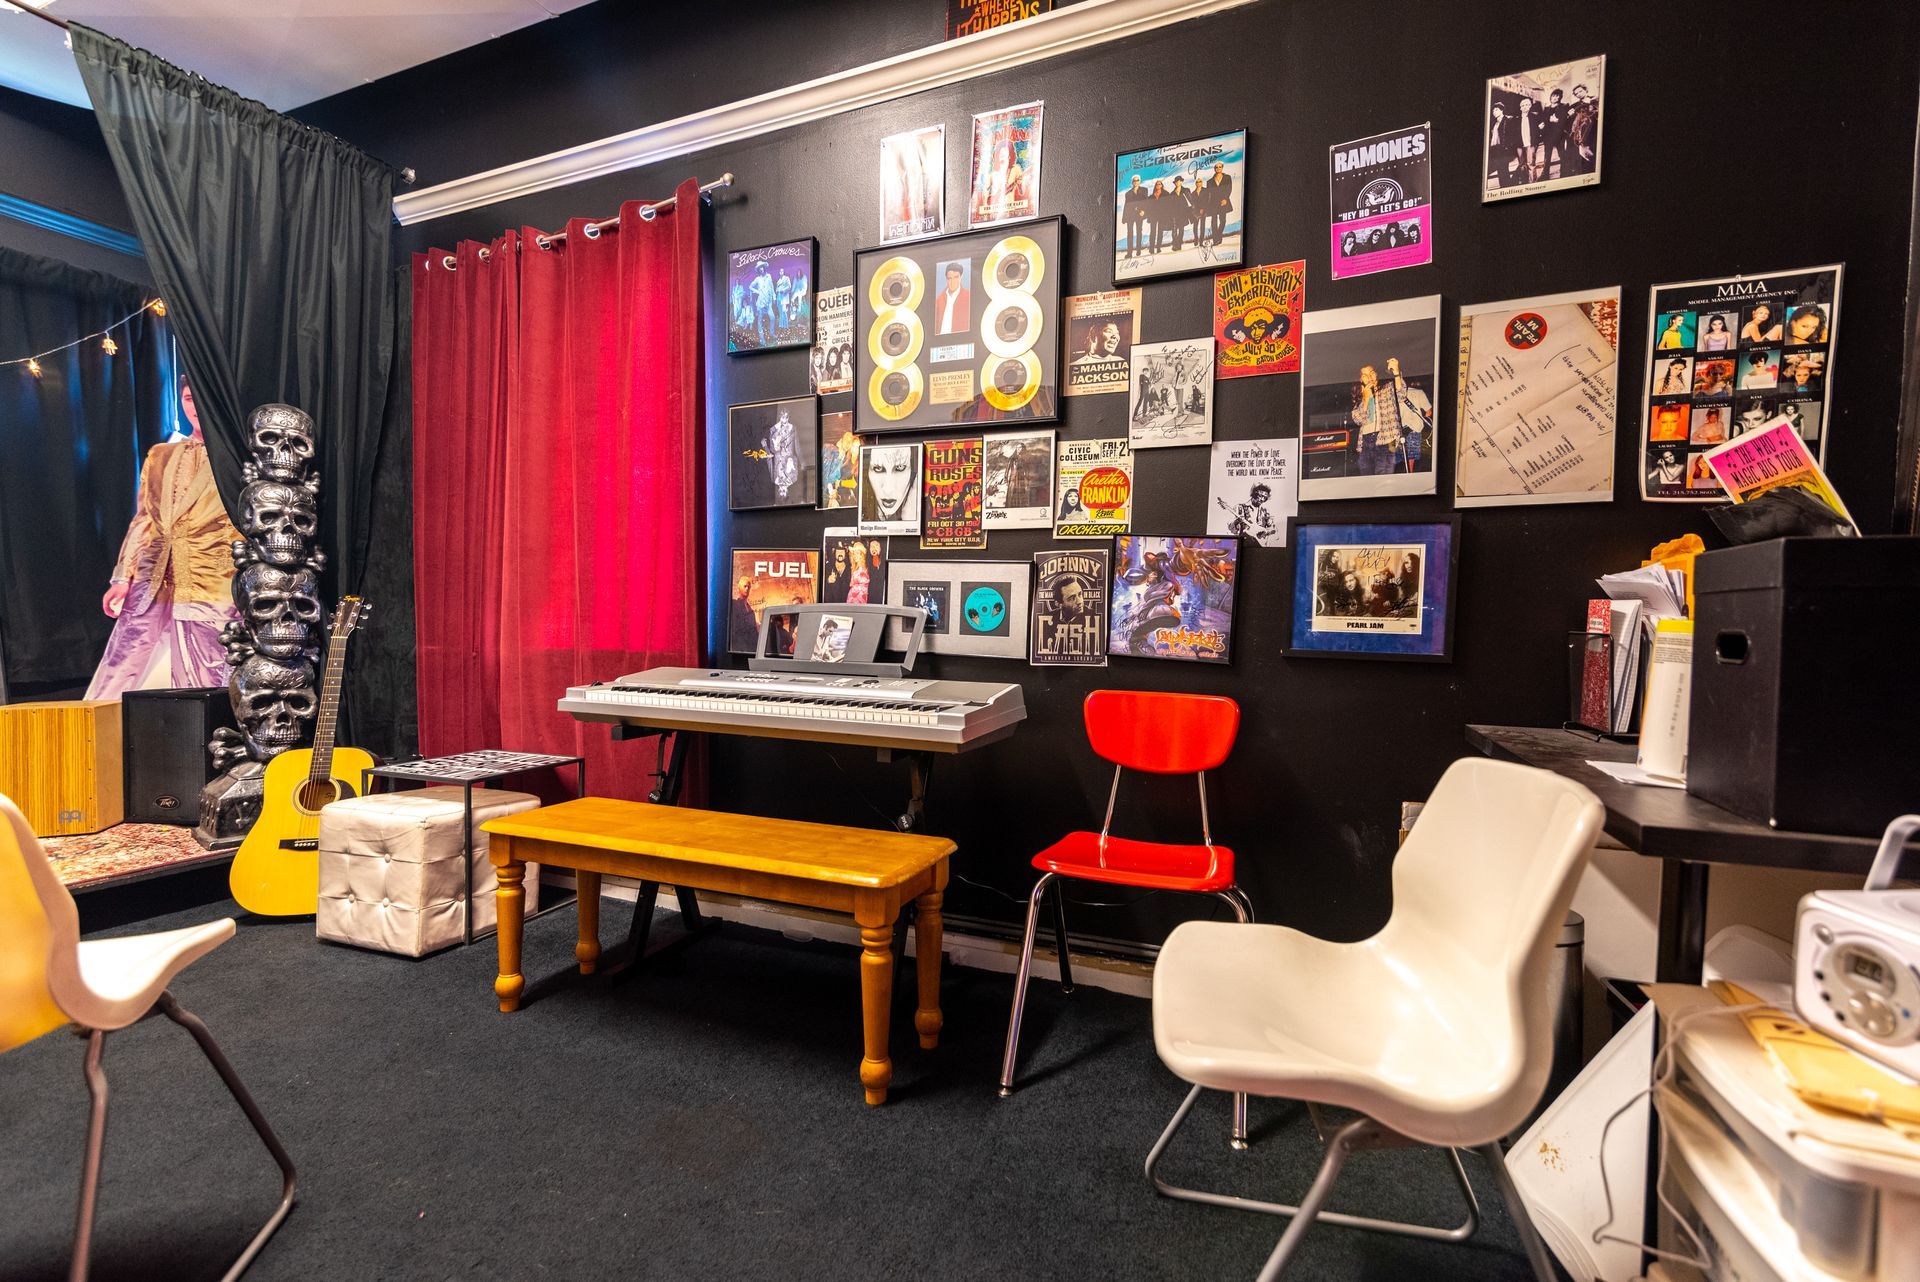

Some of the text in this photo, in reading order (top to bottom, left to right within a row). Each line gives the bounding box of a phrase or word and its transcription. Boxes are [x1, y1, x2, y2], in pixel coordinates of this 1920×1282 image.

[981, 0, 1017, 16] WHERE
[973, 1, 1039, 33] HAPPENS
[1132, 144, 1222, 169] SCORPIONS
[1335, 133, 1426, 174] RAMONES
[1500, 189, 1523, 197] Rolling
[1359, 209, 1369, 218] HO
[1380, 202, 1400, 213] LET'S
[736, 249, 768, 268] Black
[767, 247, 805, 258] Crowes
[1219, 270, 1304, 300] JIMI HENDRIX
[1717, 281, 1768, 298] MMA
[818, 294, 853, 312] QUEEN
[1102, 291, 1130, 300] AUDITORIUM
[1227, 285, 1287, 310] EXPERIENCE
[1711, 294, 1755, 304] MANAGEMENT
[1757, 290, 1783, 298] AGENCY
[832, 336, 850, 345] CIRCLE
[1514, 320, 1538, 344] PEARL
[1242, 340, 1275, 356] JULY 30
[1080, 361, 1129, 373] MAHALIA
[1072, 371, 1129, 384] JACKSON
[930, 448, 982, 465] GUNS
[1735, 438, 1776, 465] THE WHO
[930, 466, 982, 482] ROSES
[1731, 448, 1803, 489] MAGIC BUS TOUR
[1083, 470, 1126, 486] Aretha
[1081, 486, 1128, 504] FRANKLIN
[936, 527, 972, 536] CBGB
[1059, 525, 1126, 535] ORCHESTRA
[754, 561, 813, 578] FUEL
[1040, 557, 1101, 579] JOHNNY
[1038, 615, 1100, 655] CASH
